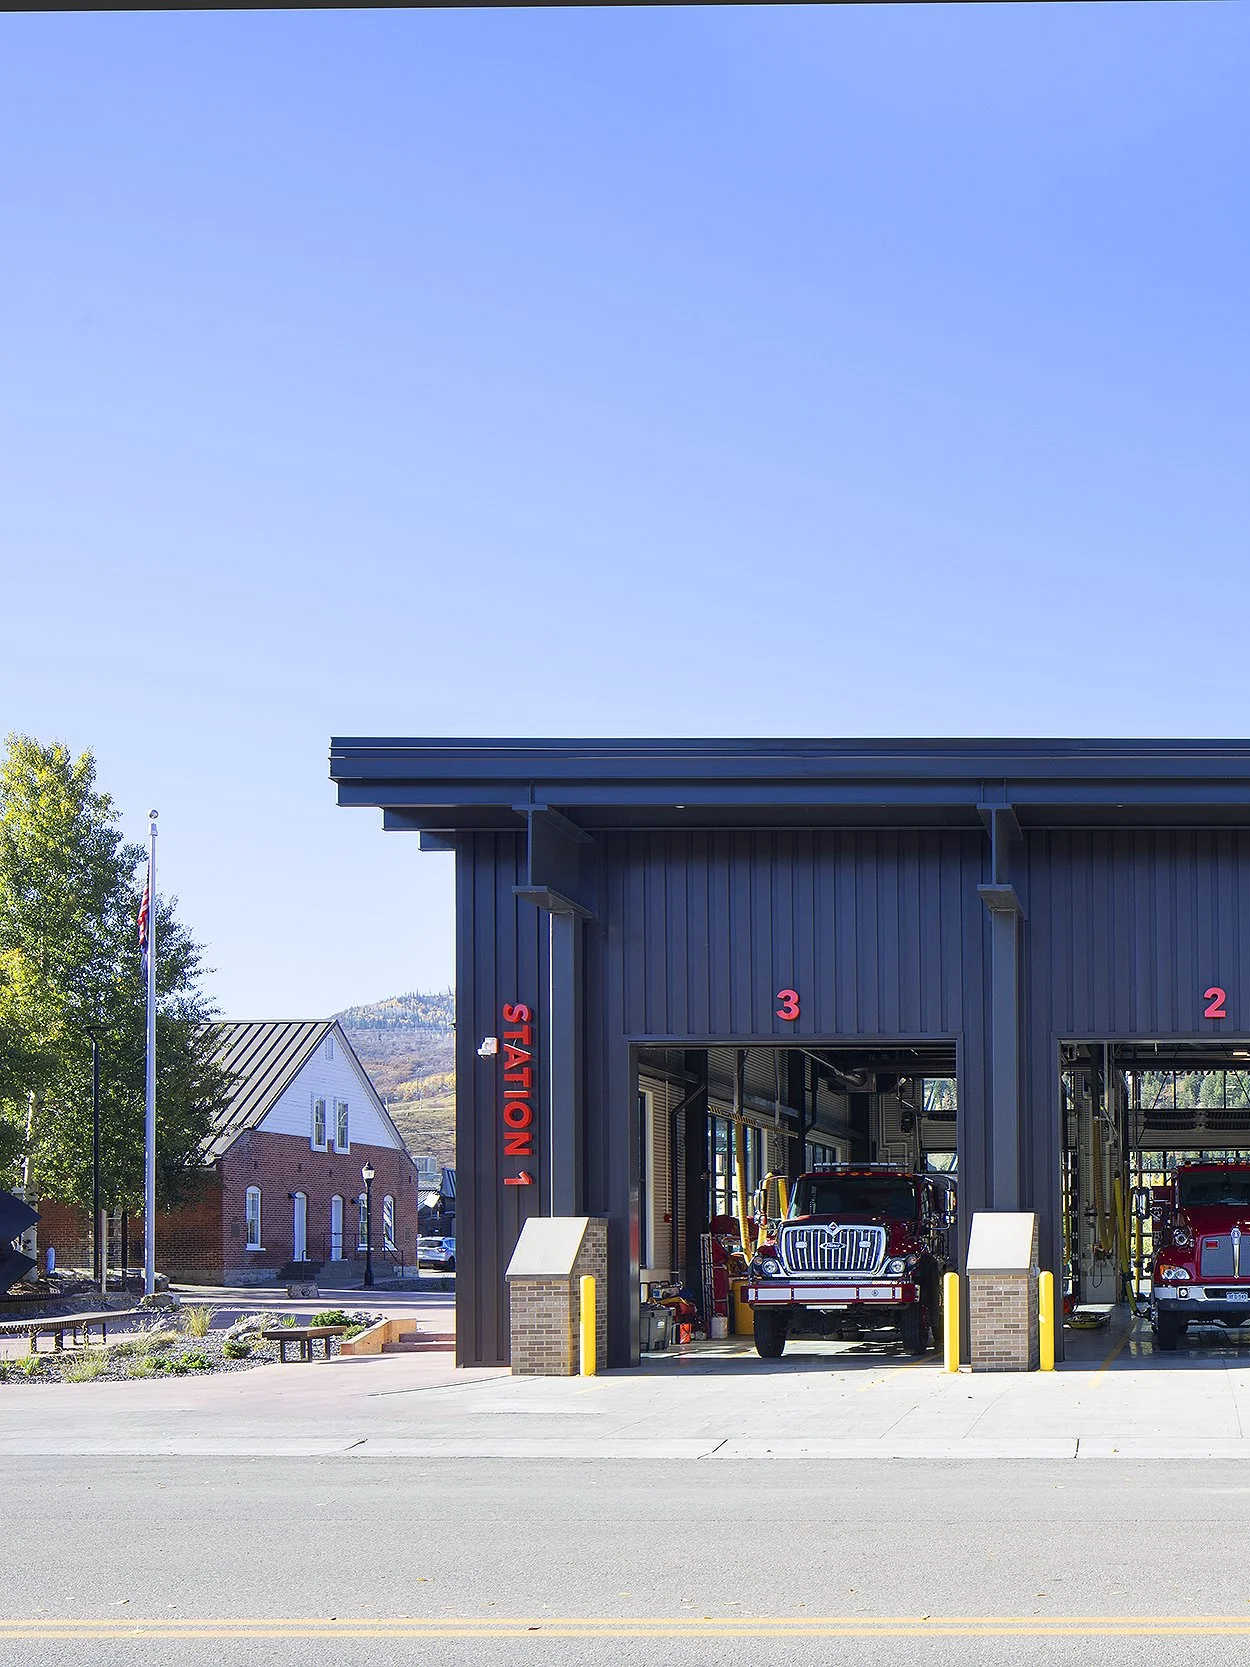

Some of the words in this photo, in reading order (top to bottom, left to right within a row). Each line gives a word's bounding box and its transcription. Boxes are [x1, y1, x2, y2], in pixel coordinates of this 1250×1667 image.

[776, 989, 800, 1021] 3
[1203, 987, 1226, 1018] 2
[503, 1003, 533, 1156] STATION
[503, 1171, 533, 1186] 1
